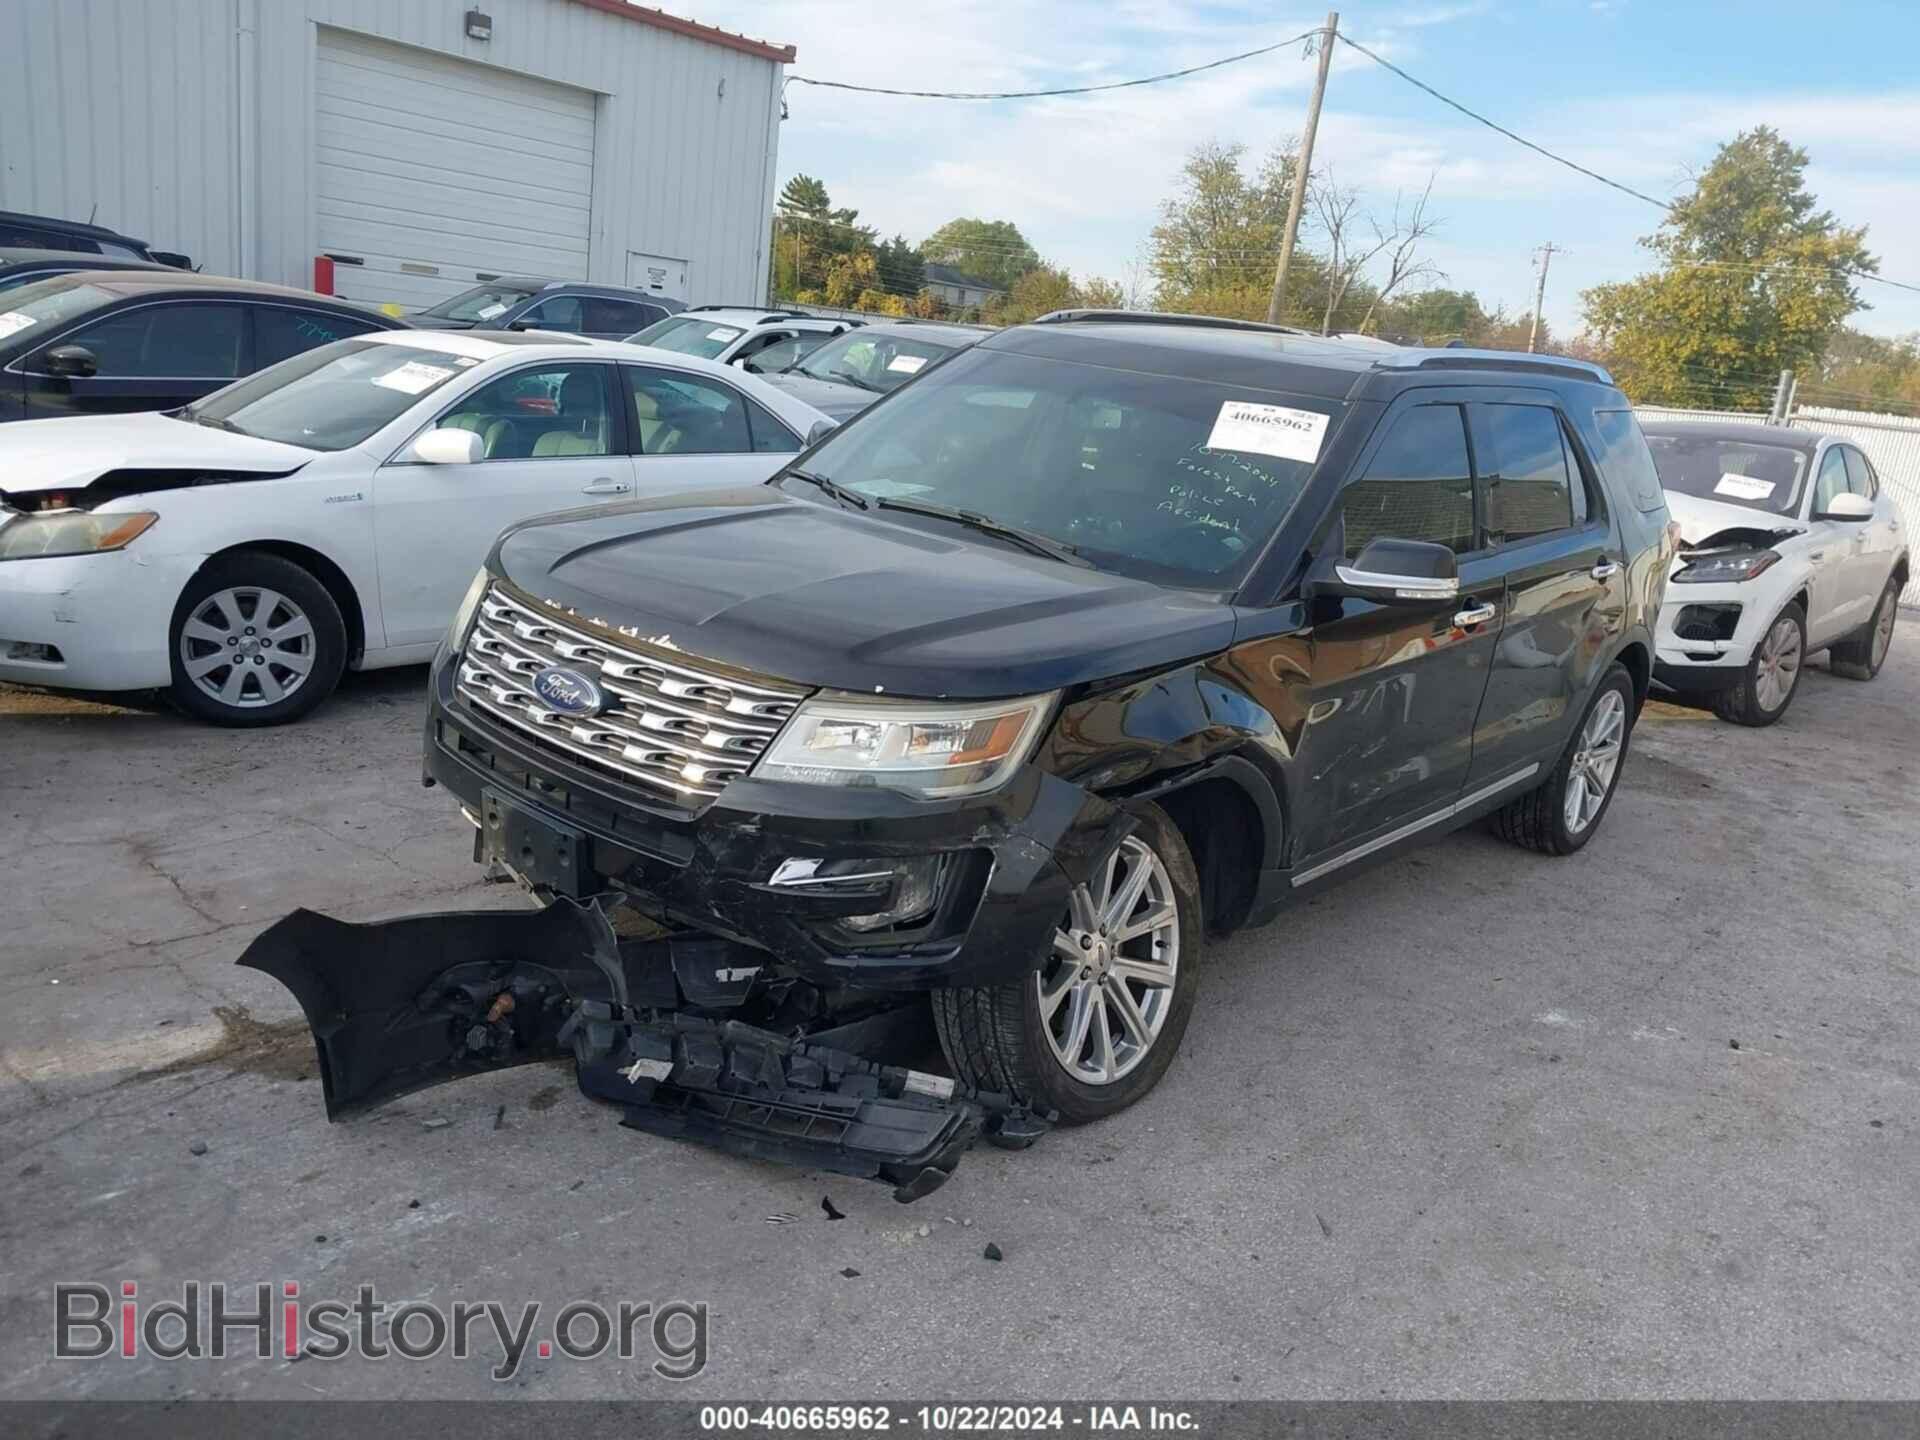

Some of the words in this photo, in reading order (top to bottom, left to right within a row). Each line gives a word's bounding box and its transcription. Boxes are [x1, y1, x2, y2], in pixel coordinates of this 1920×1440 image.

[1230, 411, 1313, 432] 40665962
[1176, 457, 1231, 483] Forest
[541, 674, 580, 705] Ford
